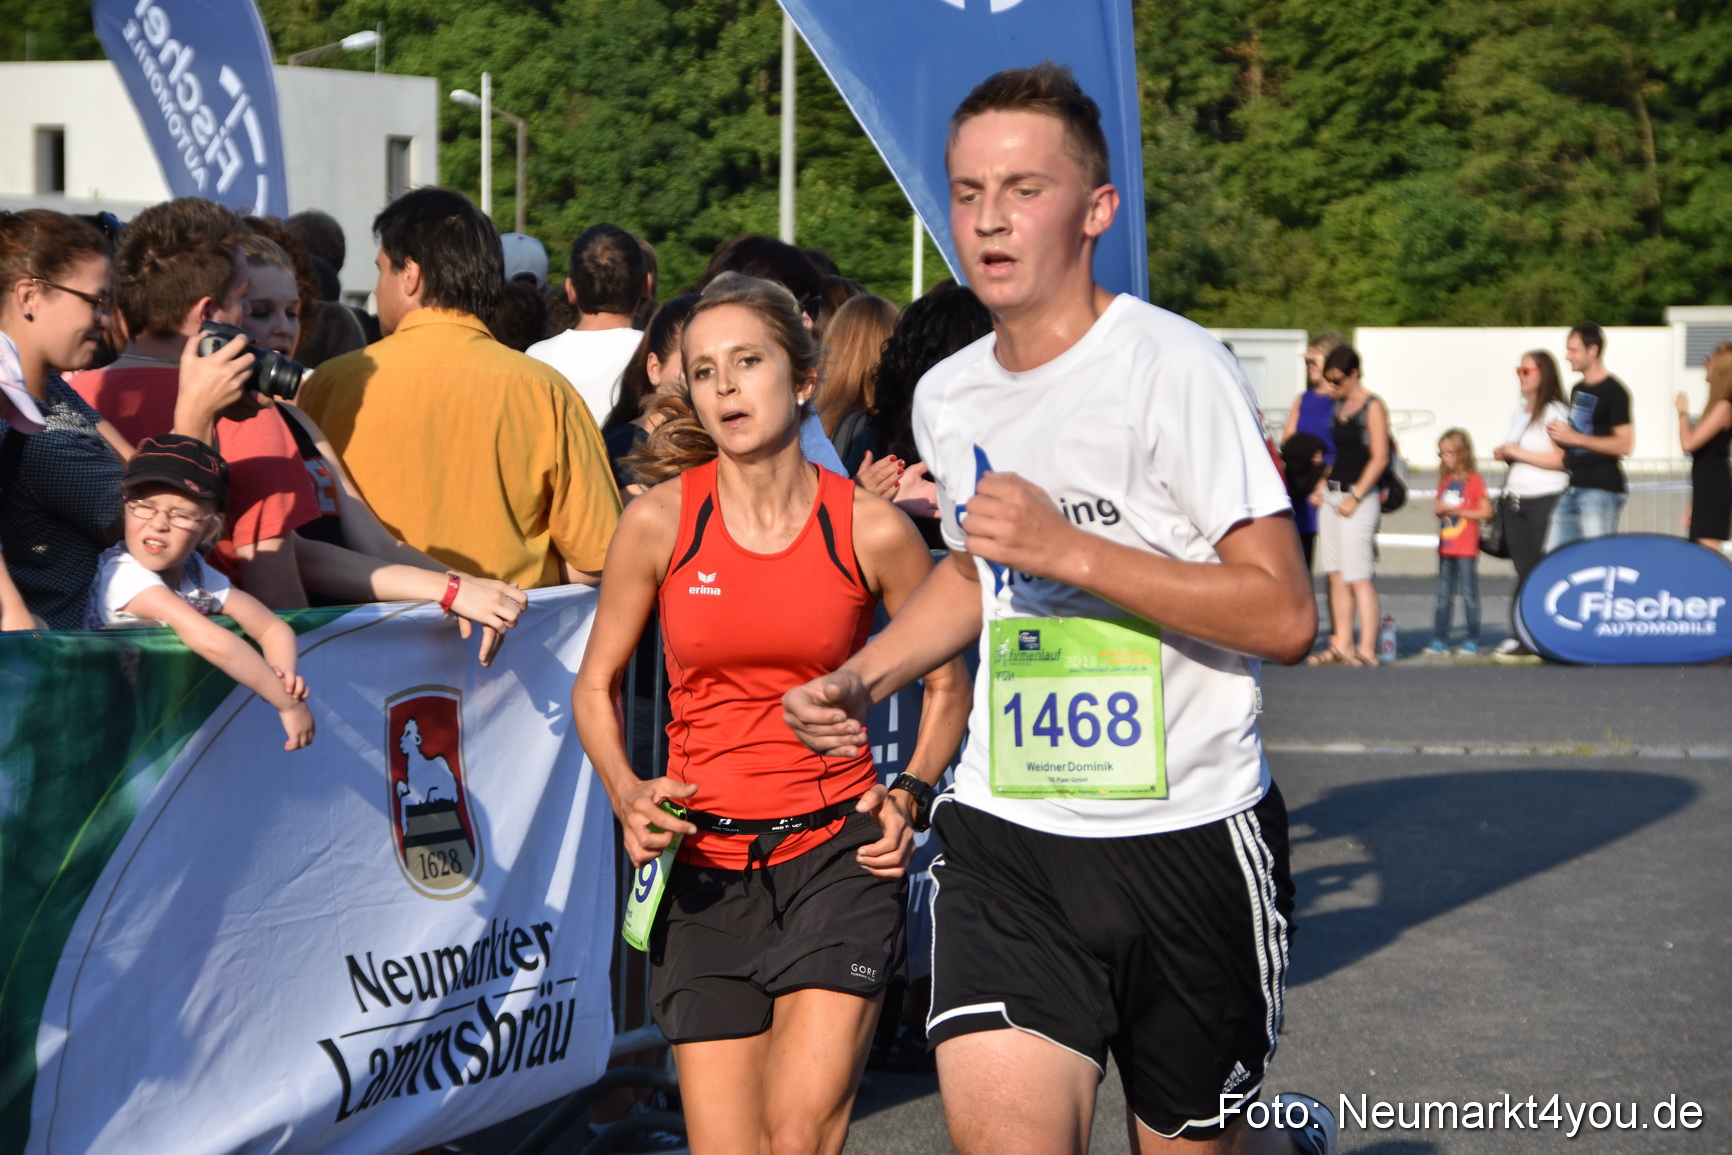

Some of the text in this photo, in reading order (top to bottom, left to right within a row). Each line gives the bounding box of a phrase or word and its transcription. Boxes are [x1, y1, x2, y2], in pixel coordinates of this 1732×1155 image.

[1060, 498, 1121, 526] ing
[689, 584, 721, 596] erima
[1577, 590, 1727, 622] Fischer
[1594, 620, 1717, 637] AUTOMOBILE
[1004, 691, 1142, 748] 1468
[1026, 761, 1114, 772] Weidner Dominik
[419, 848, 463, 880] 1628
[635, 858, 658, 904] 9
[345, 918, 553, 1014] Neumarkter
[851, 963, 877, 978] GORE
[317, 980, 576, 1123] Lammsbräu
